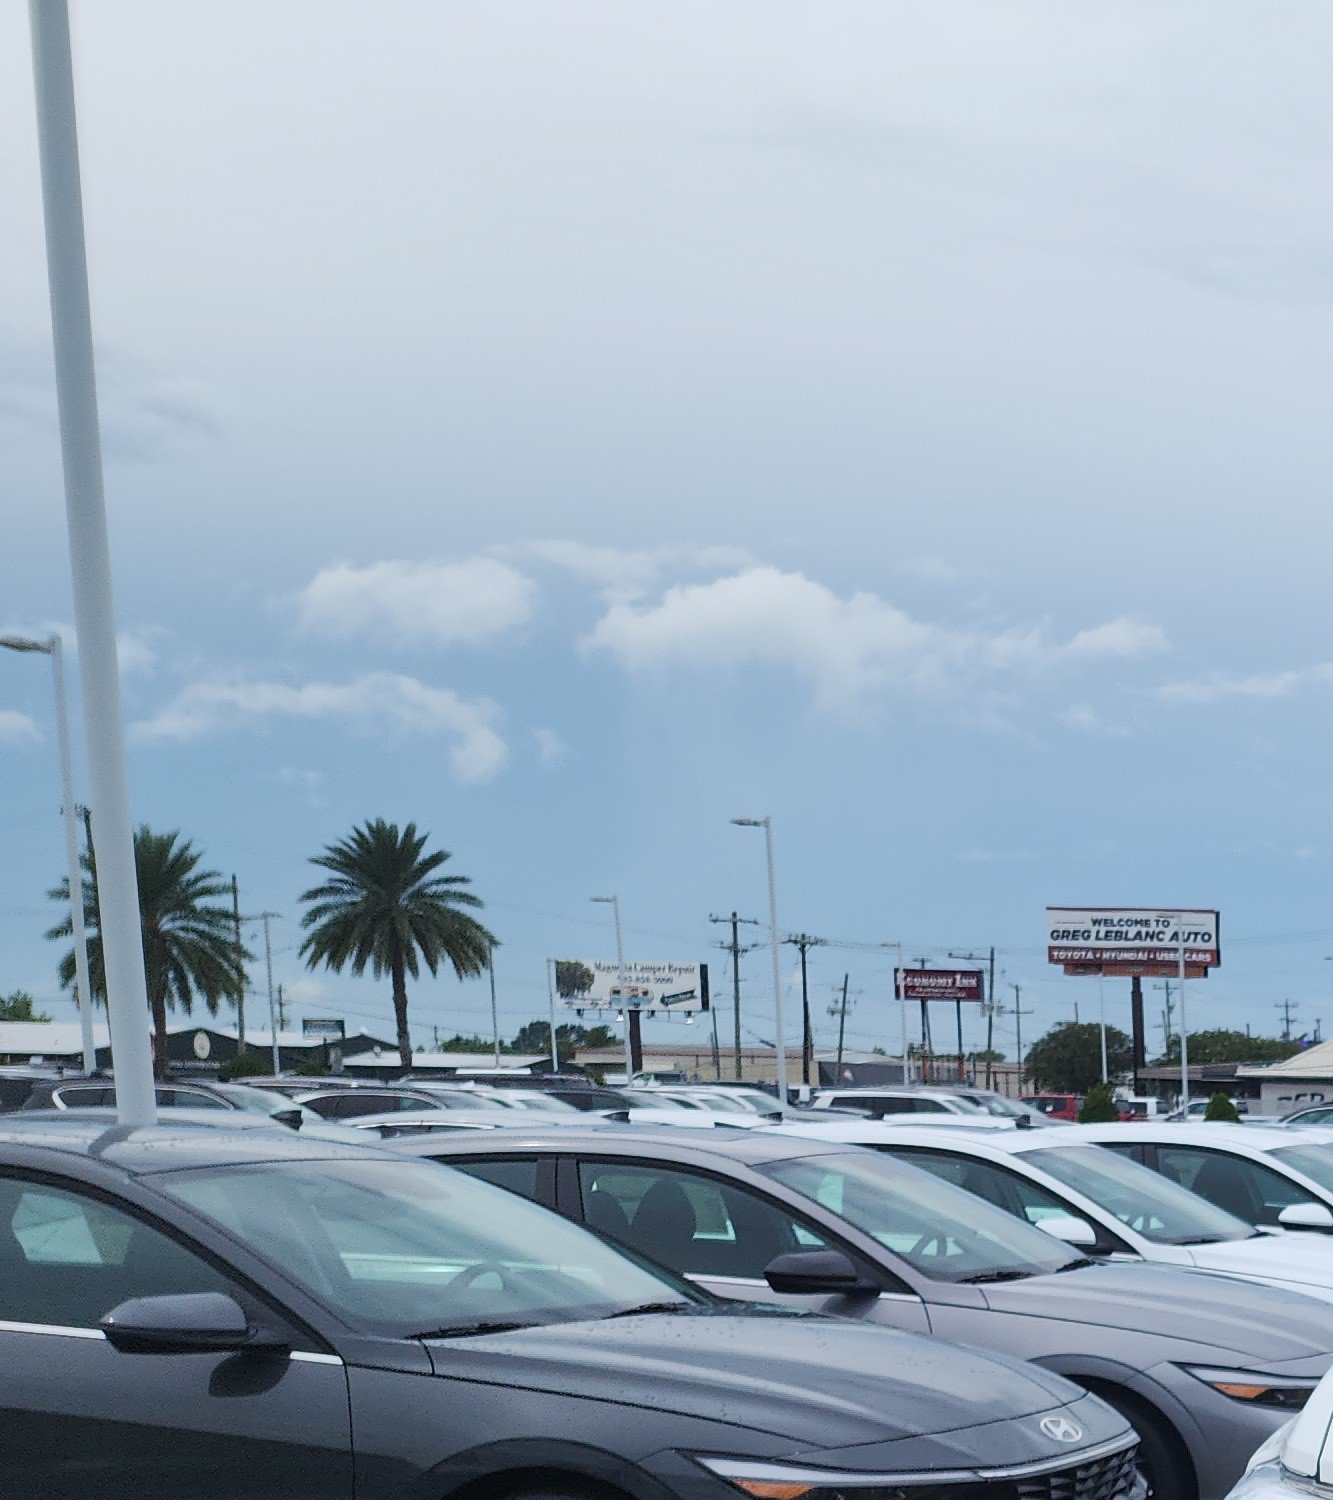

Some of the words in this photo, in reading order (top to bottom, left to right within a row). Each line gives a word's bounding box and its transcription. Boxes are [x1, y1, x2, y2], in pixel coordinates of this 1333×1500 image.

[1091, 918, 1151, 928] WELCOME
[1155, 919, 1170, 928] TO
[1051, 929, 1091, 941] GREG
[1094, 930, 1165, 943] LEBLANC
[1168, 931, 1212, 943] AUTO
[1052, 951, 1095, 960] TOYOTA
[1102, 951, 1148, 961] HYUNDAI
[1184, 953, 1212, 962] CARS
